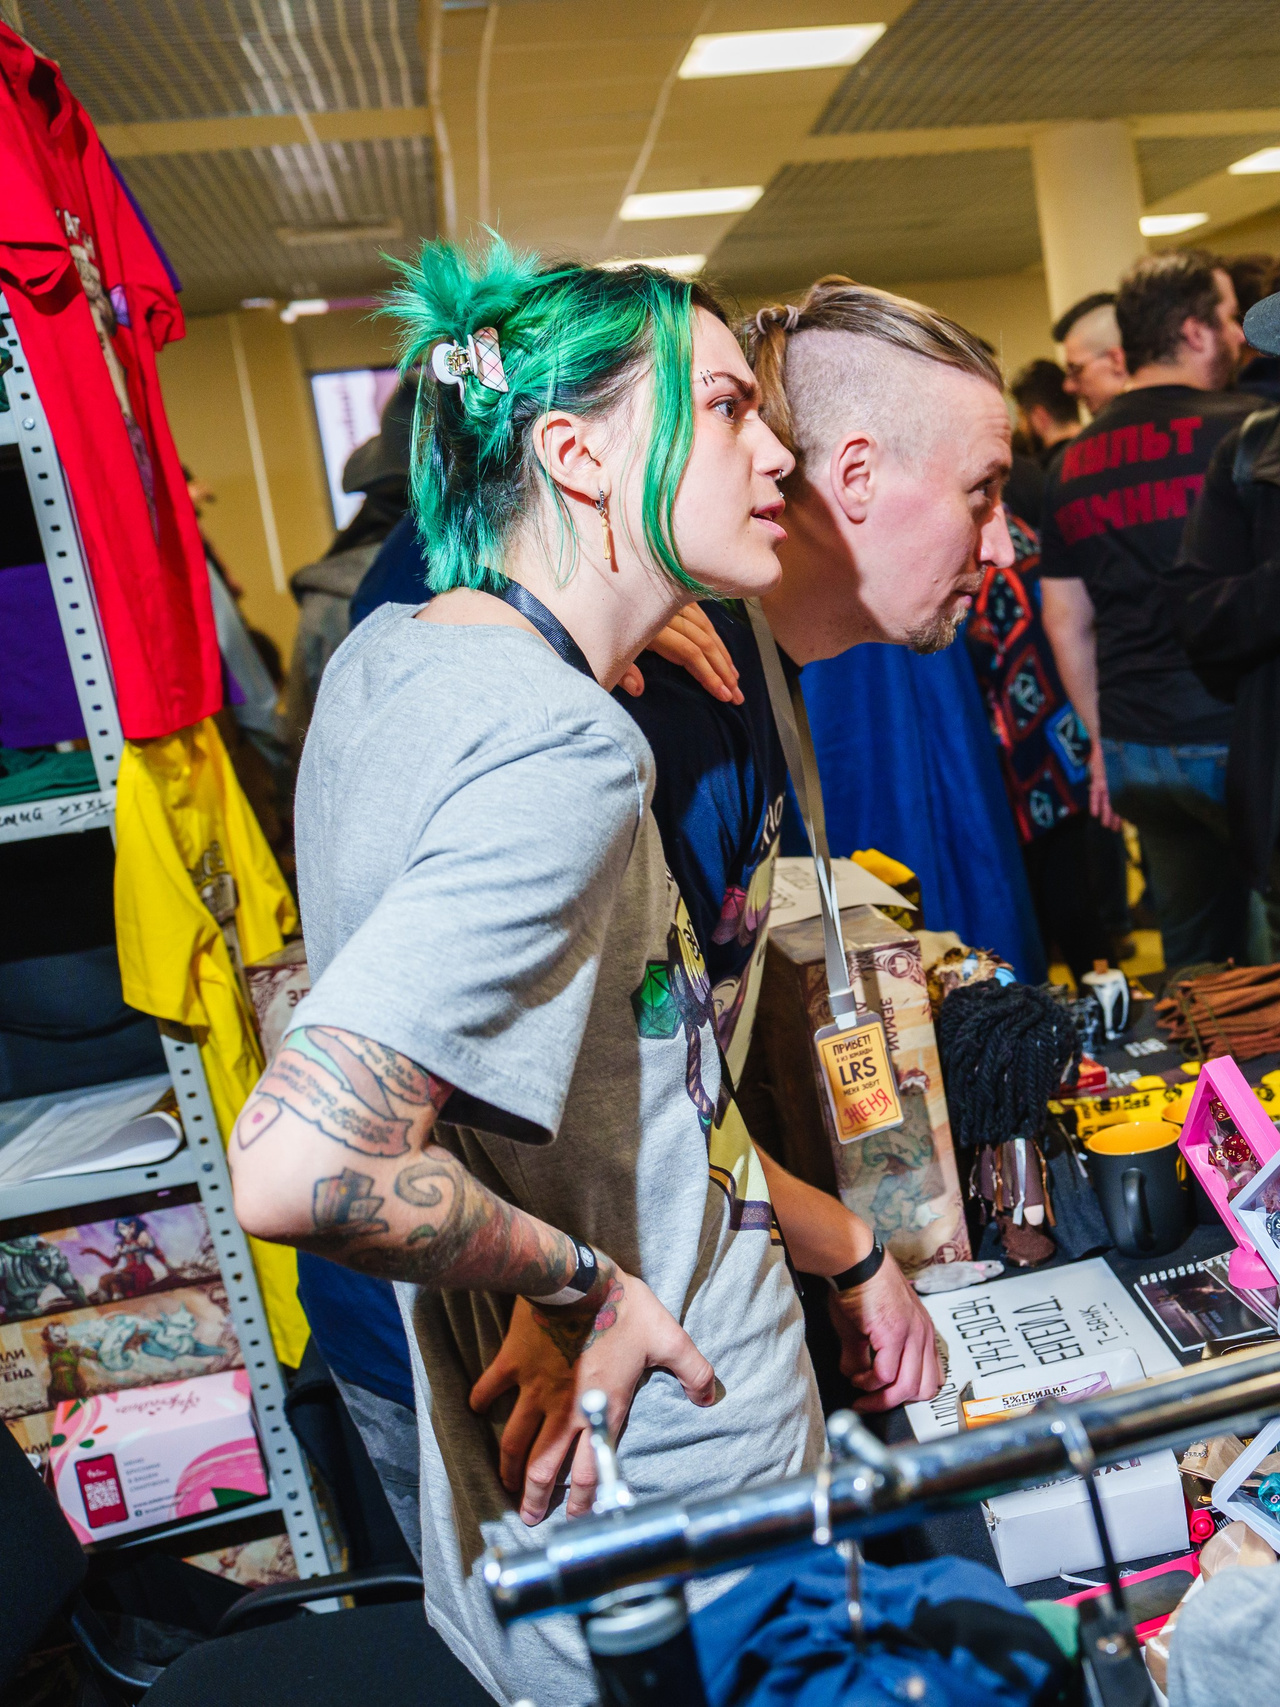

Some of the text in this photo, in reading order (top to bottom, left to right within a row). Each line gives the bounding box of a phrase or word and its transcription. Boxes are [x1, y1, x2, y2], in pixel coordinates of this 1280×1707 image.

[832, 1034, 871, 1056] ПРИВЕТ!
[838, 1056, 877, 1086] LRS
[843, 1088, 893, 1130] ЖЕНЯ
[1021, 1385, 1068, 1402] СКИДКА
